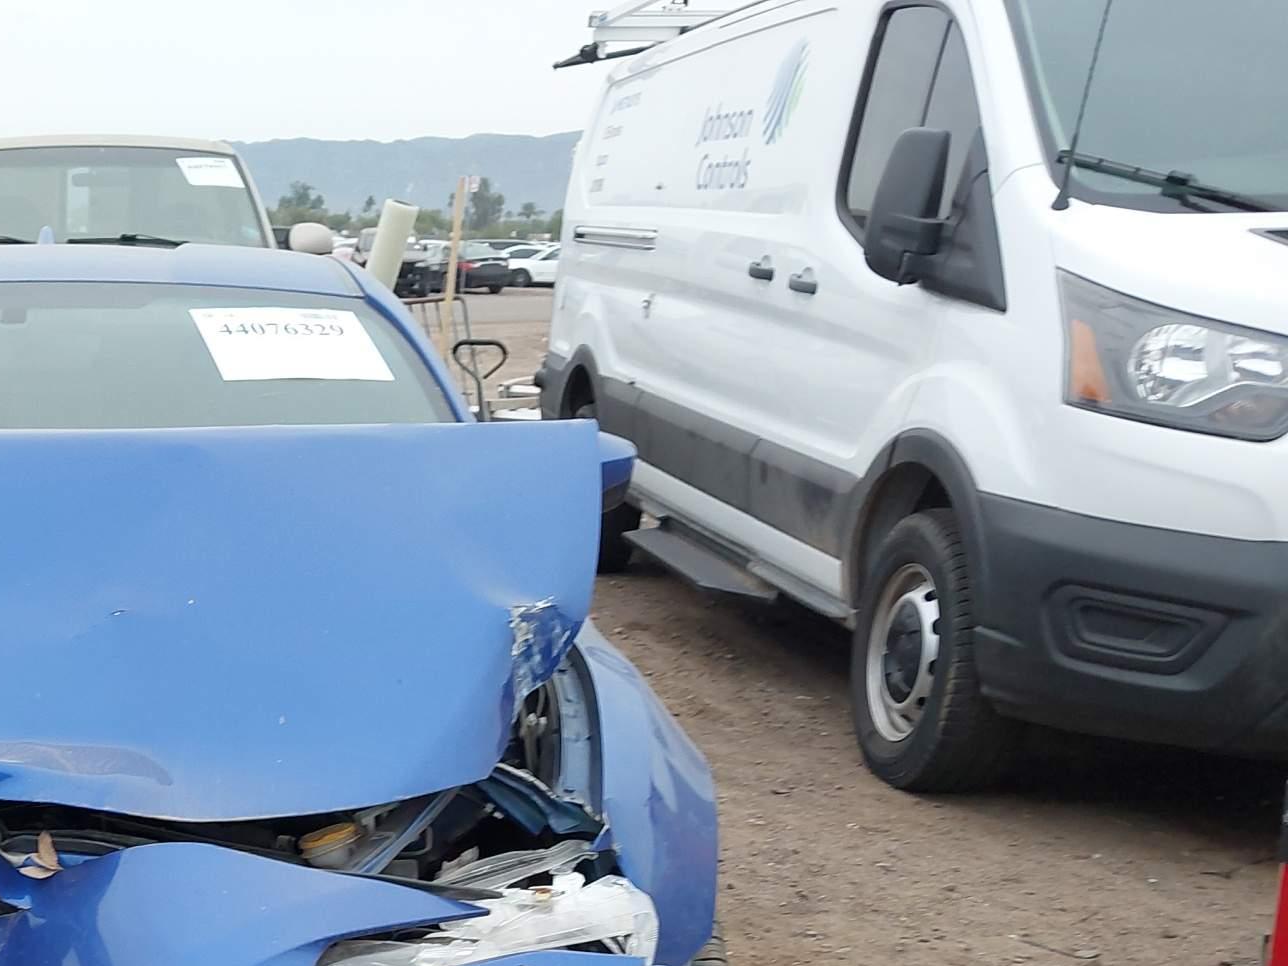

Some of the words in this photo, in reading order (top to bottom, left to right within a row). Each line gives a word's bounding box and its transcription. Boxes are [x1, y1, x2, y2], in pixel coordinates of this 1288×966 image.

[695, 101, 755, 148] Johnson
[696, 147, 752, 190] Controls
[218, 322, 346, 337] 44076329
